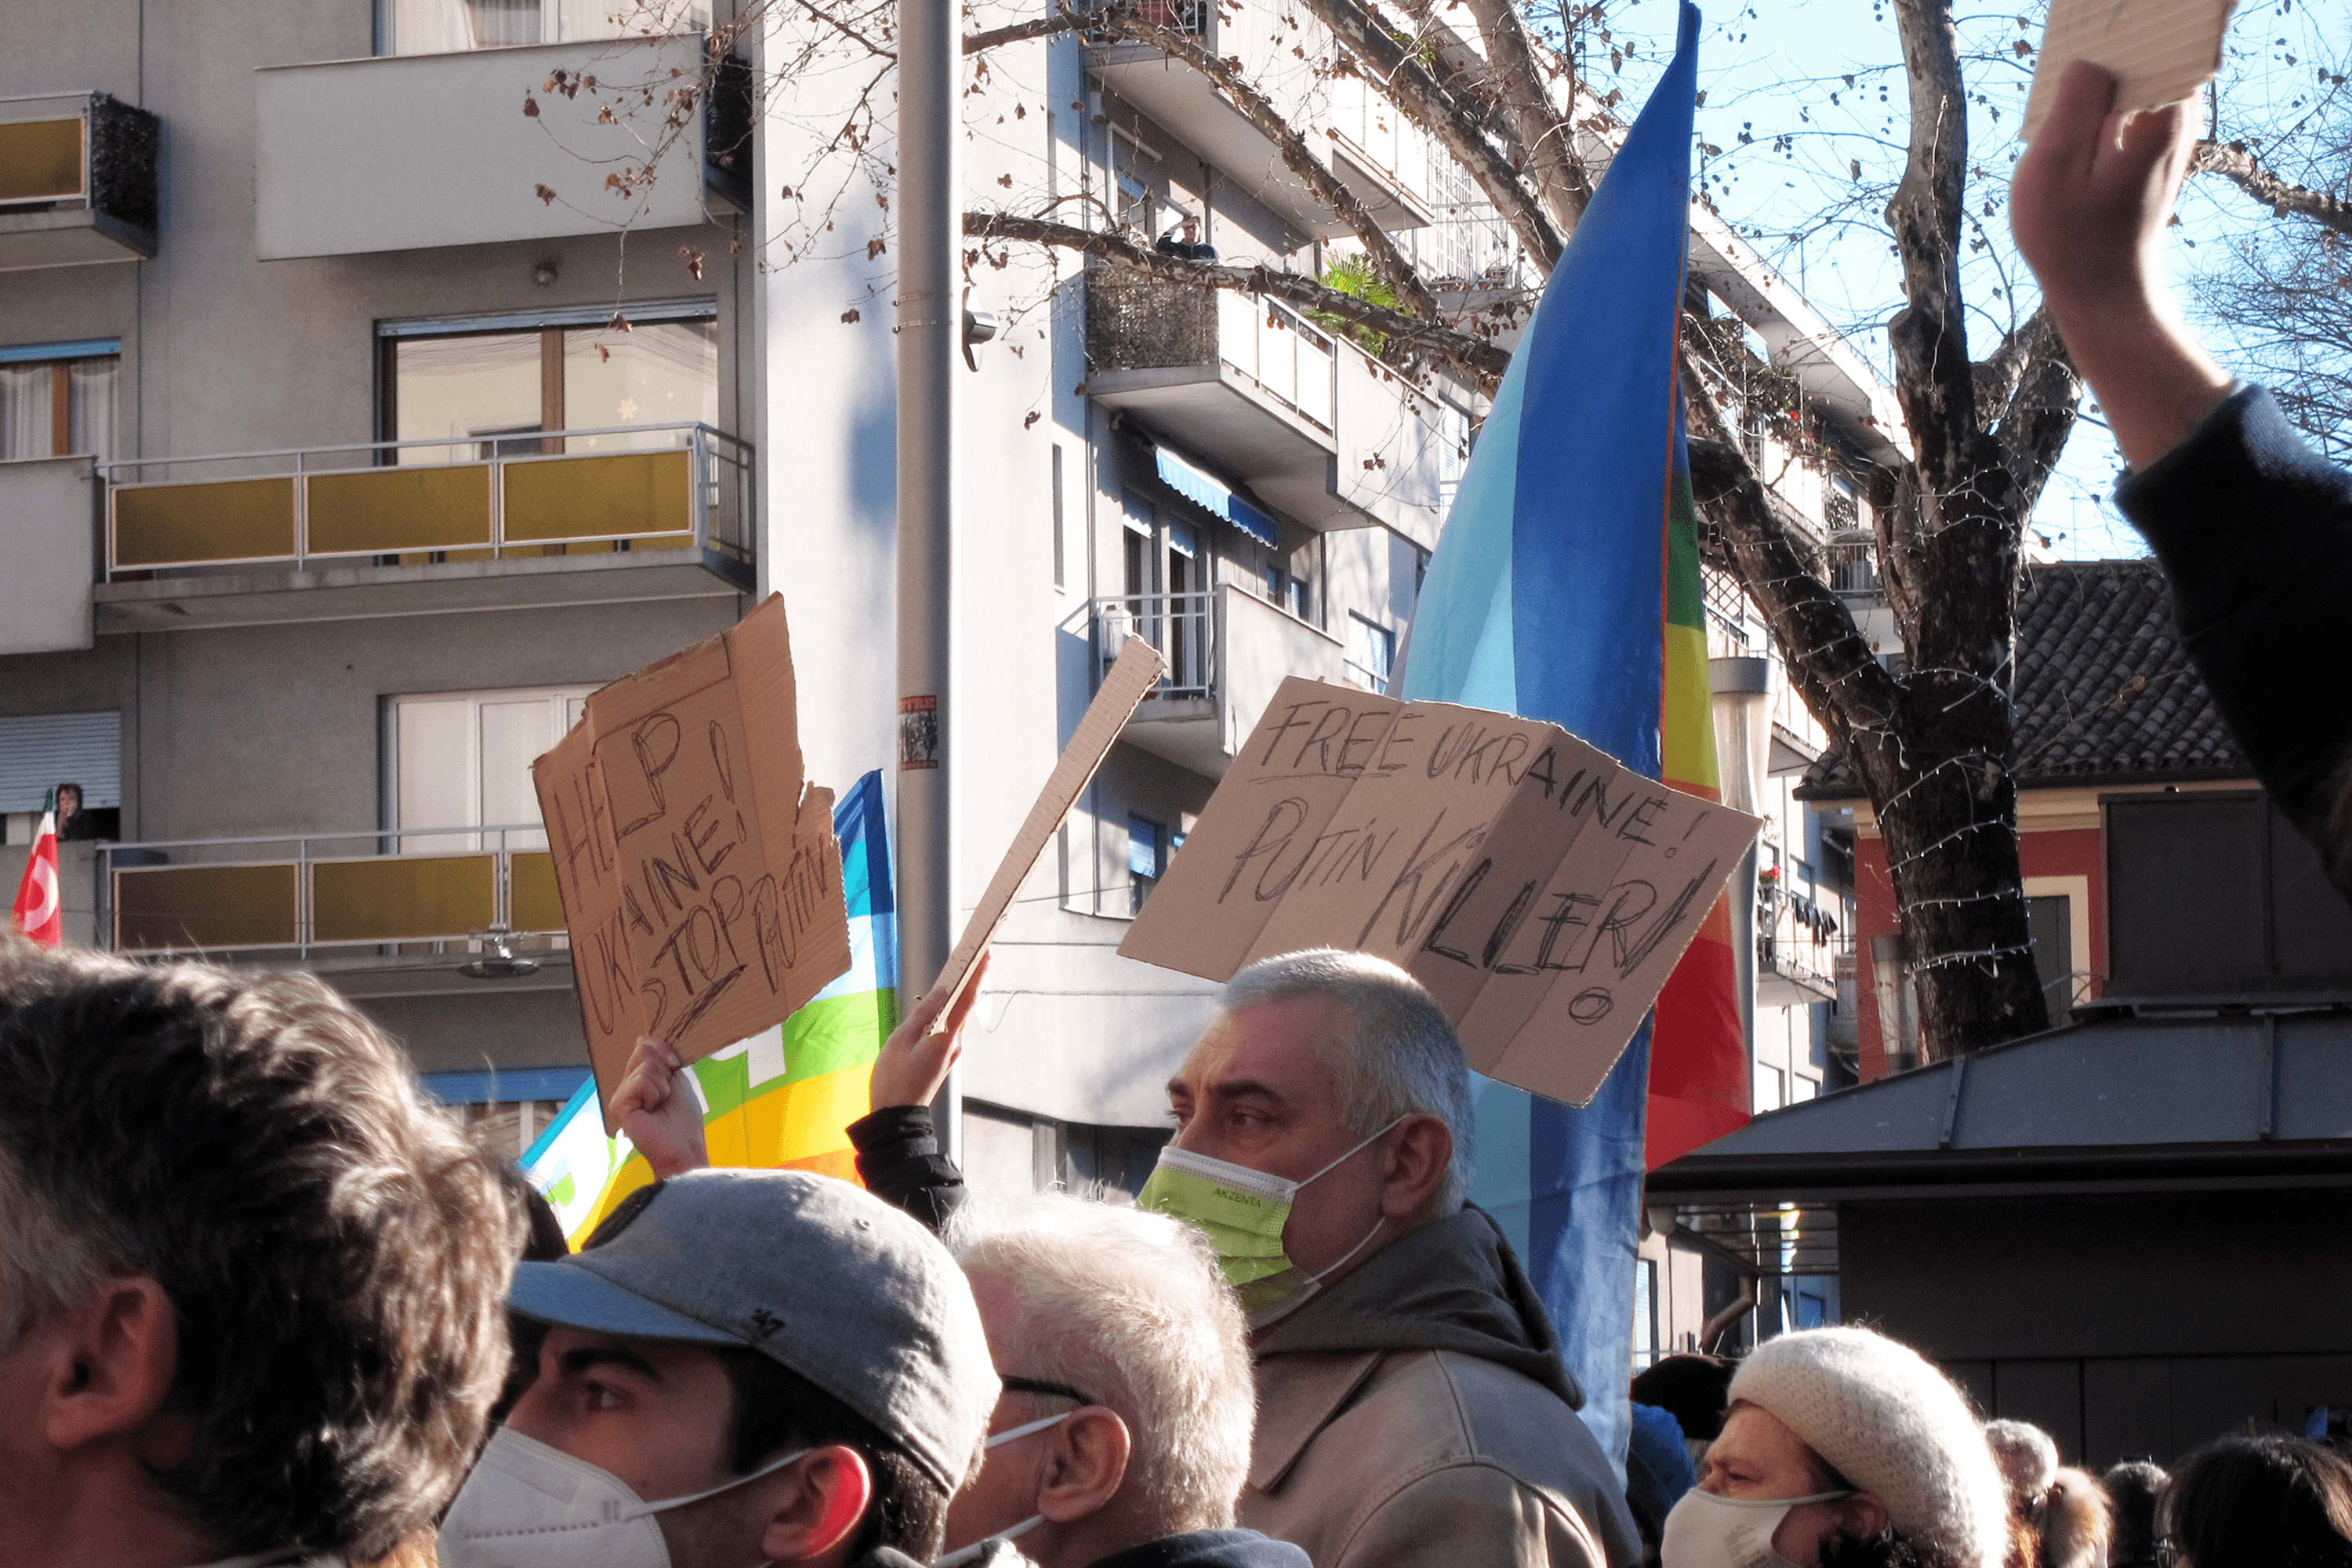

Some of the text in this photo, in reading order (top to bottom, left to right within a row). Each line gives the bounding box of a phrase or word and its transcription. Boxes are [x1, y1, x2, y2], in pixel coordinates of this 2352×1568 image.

[1261, 700, 1710, 859] FREE UKRAINE!
[1214, 1188, 1261, 1208] AKZENTA
